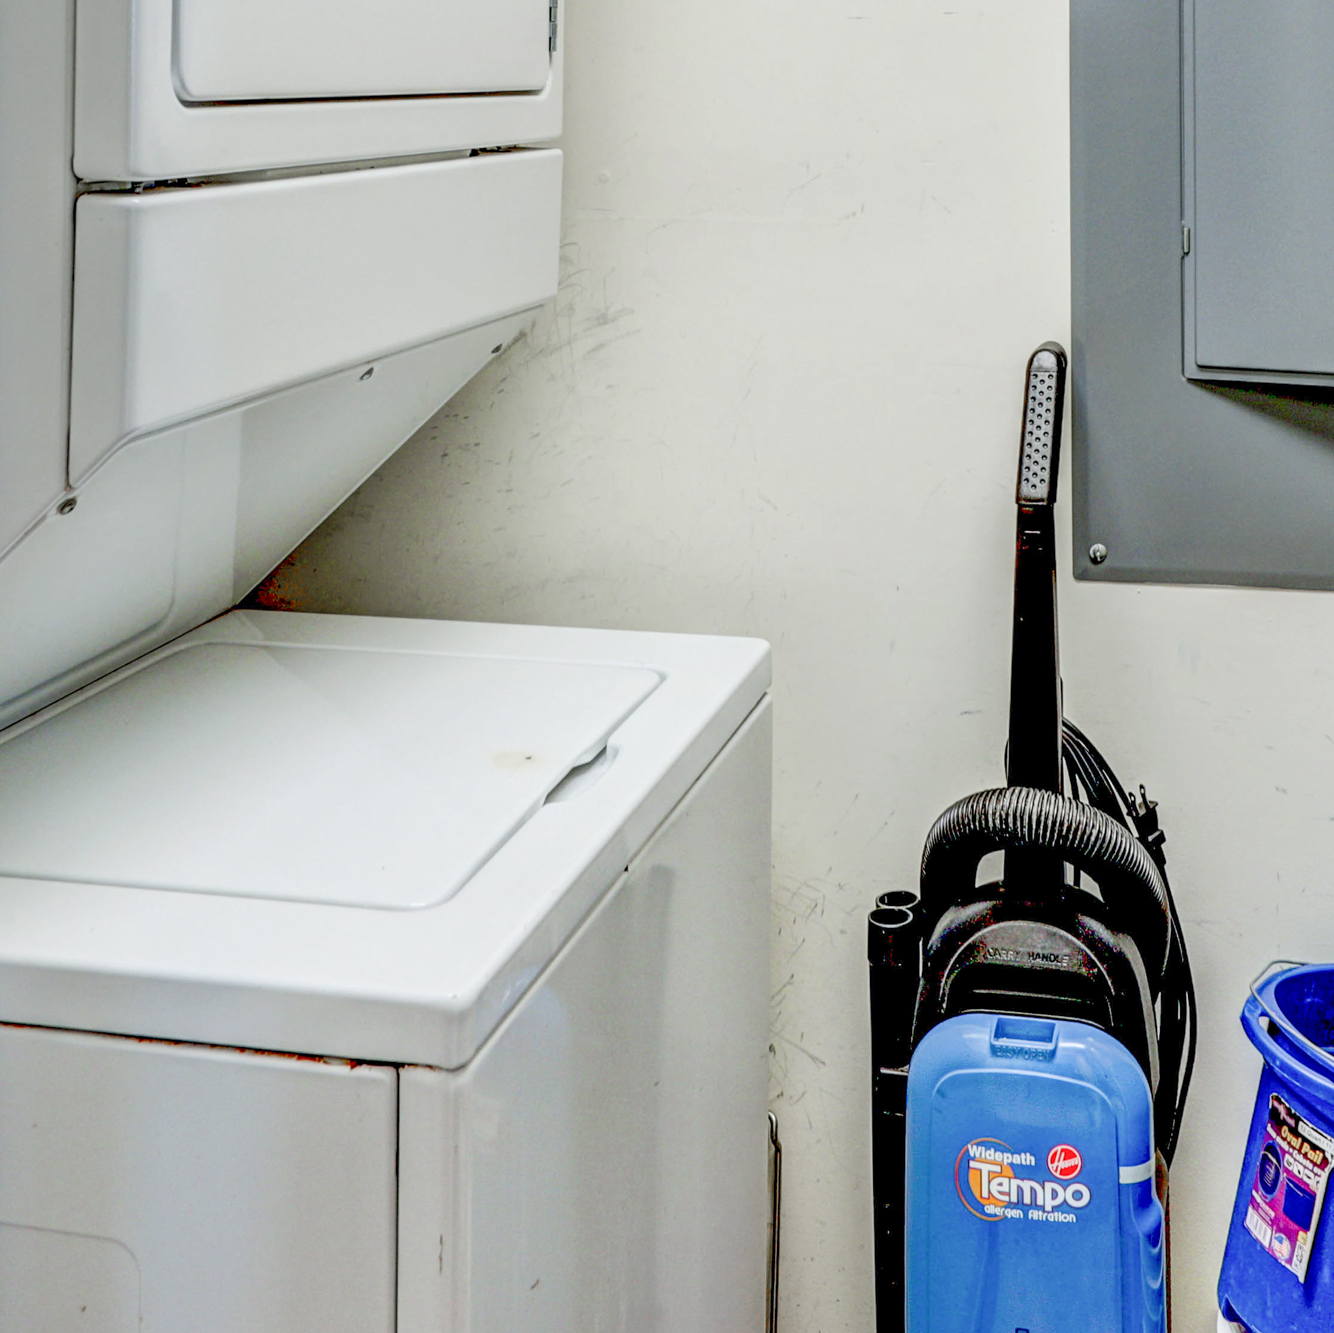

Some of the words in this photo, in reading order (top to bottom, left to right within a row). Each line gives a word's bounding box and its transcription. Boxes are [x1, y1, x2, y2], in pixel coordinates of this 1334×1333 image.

[987, 948, 1020, 961] CARRY
[1028, 952, 1068, 966] HANDLE
[995, 1045, 1020, 1059] EASY
[1024, 1048, 1051, 1061] OPEN
[968, 1144, 1036, 1166] Widepath
[1281, 1125, 1302, 1150] Oval
[1301, 1141, 1324, 1165] Pail
[969, 1159, 1091, 1212] Tempo
[984, 1204, 1023, 1219] allergen
[1028, 1210, 1076, 1223] filtration
